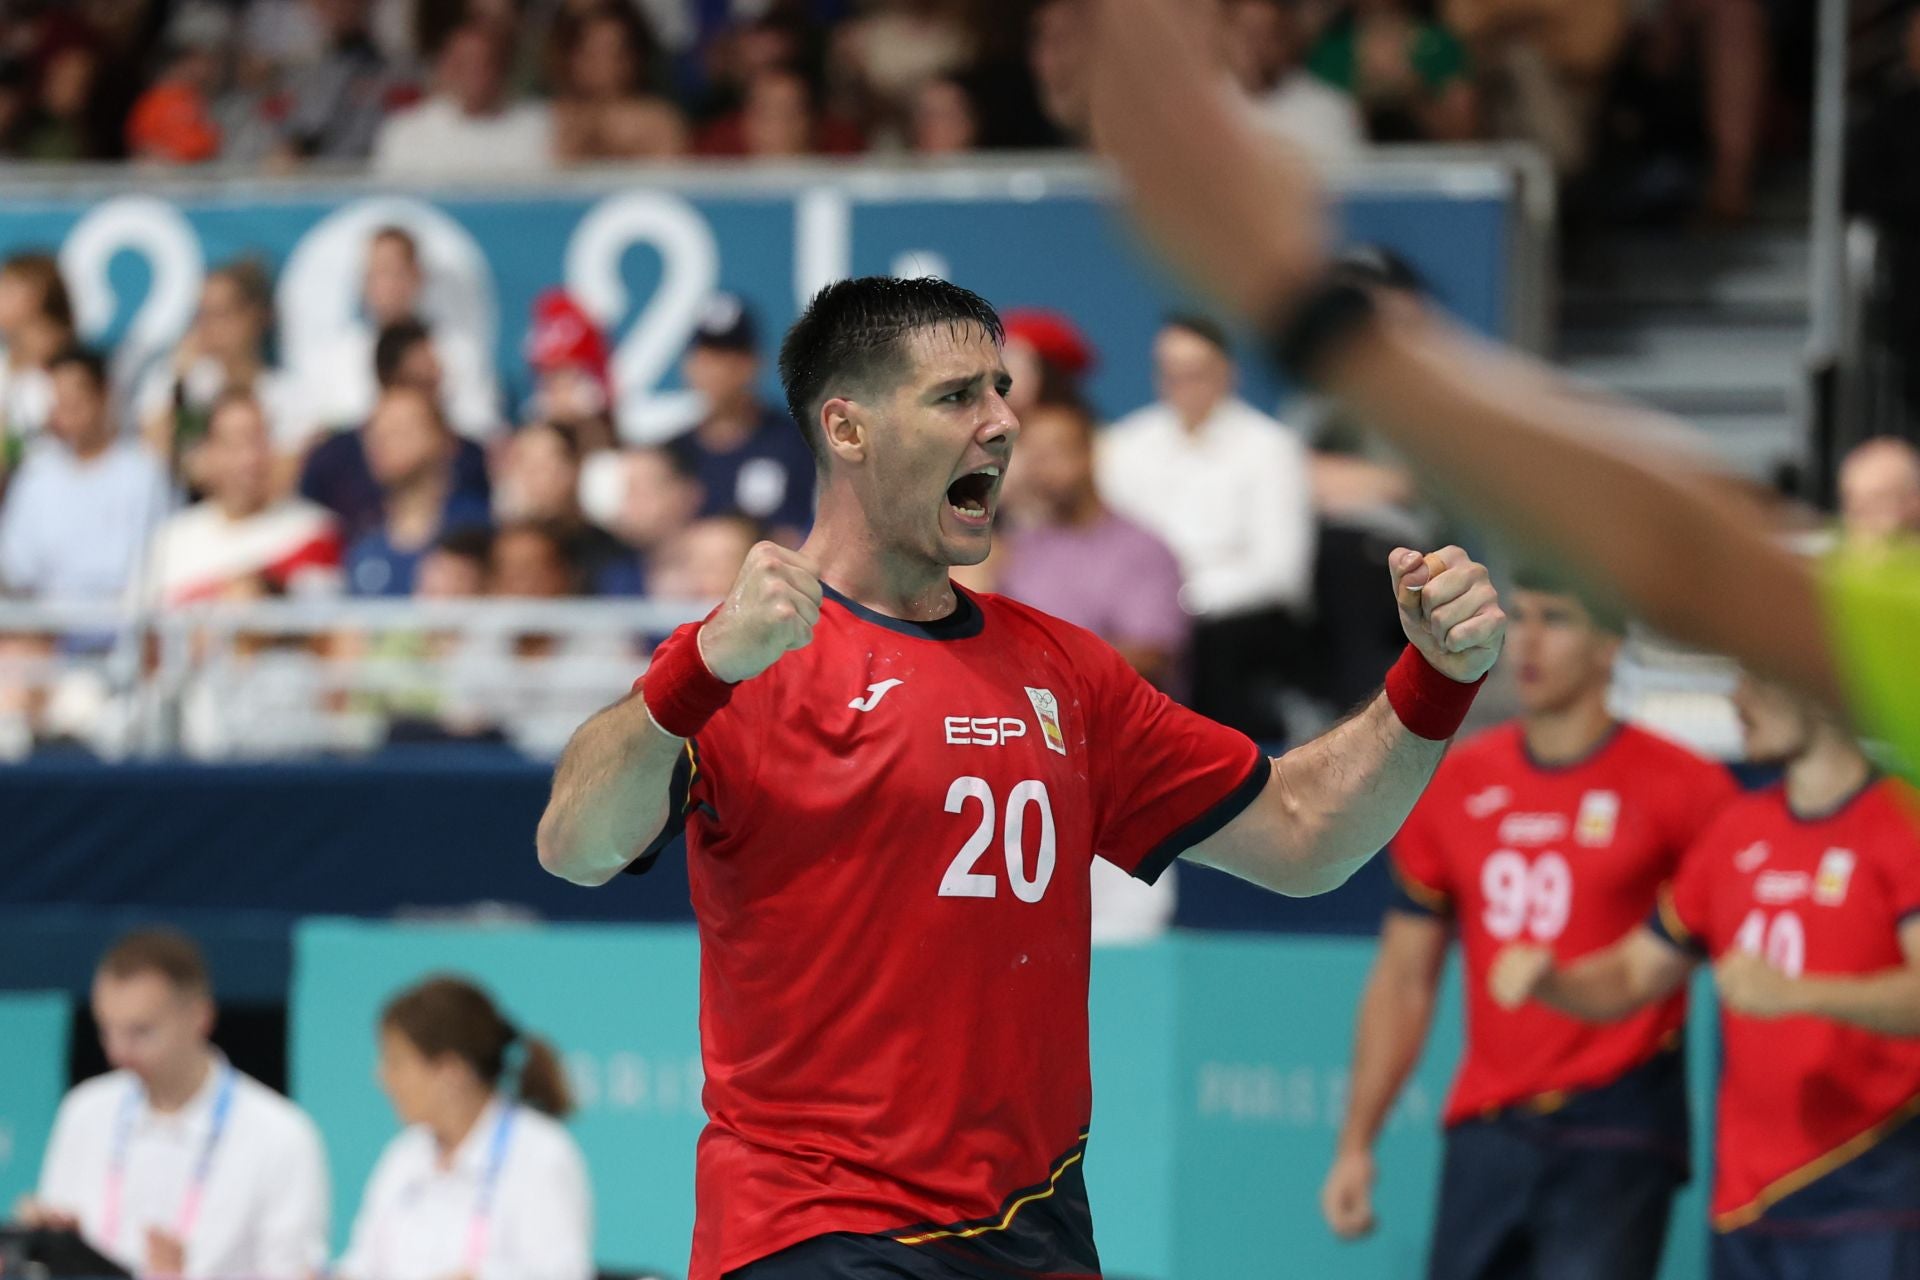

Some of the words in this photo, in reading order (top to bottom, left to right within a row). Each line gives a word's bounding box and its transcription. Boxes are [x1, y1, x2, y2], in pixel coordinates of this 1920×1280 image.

[944, 716, 1027, 746] ESP
[938, 776, 1056, 904] 20
[1480, 850, 1573, 941] 99
